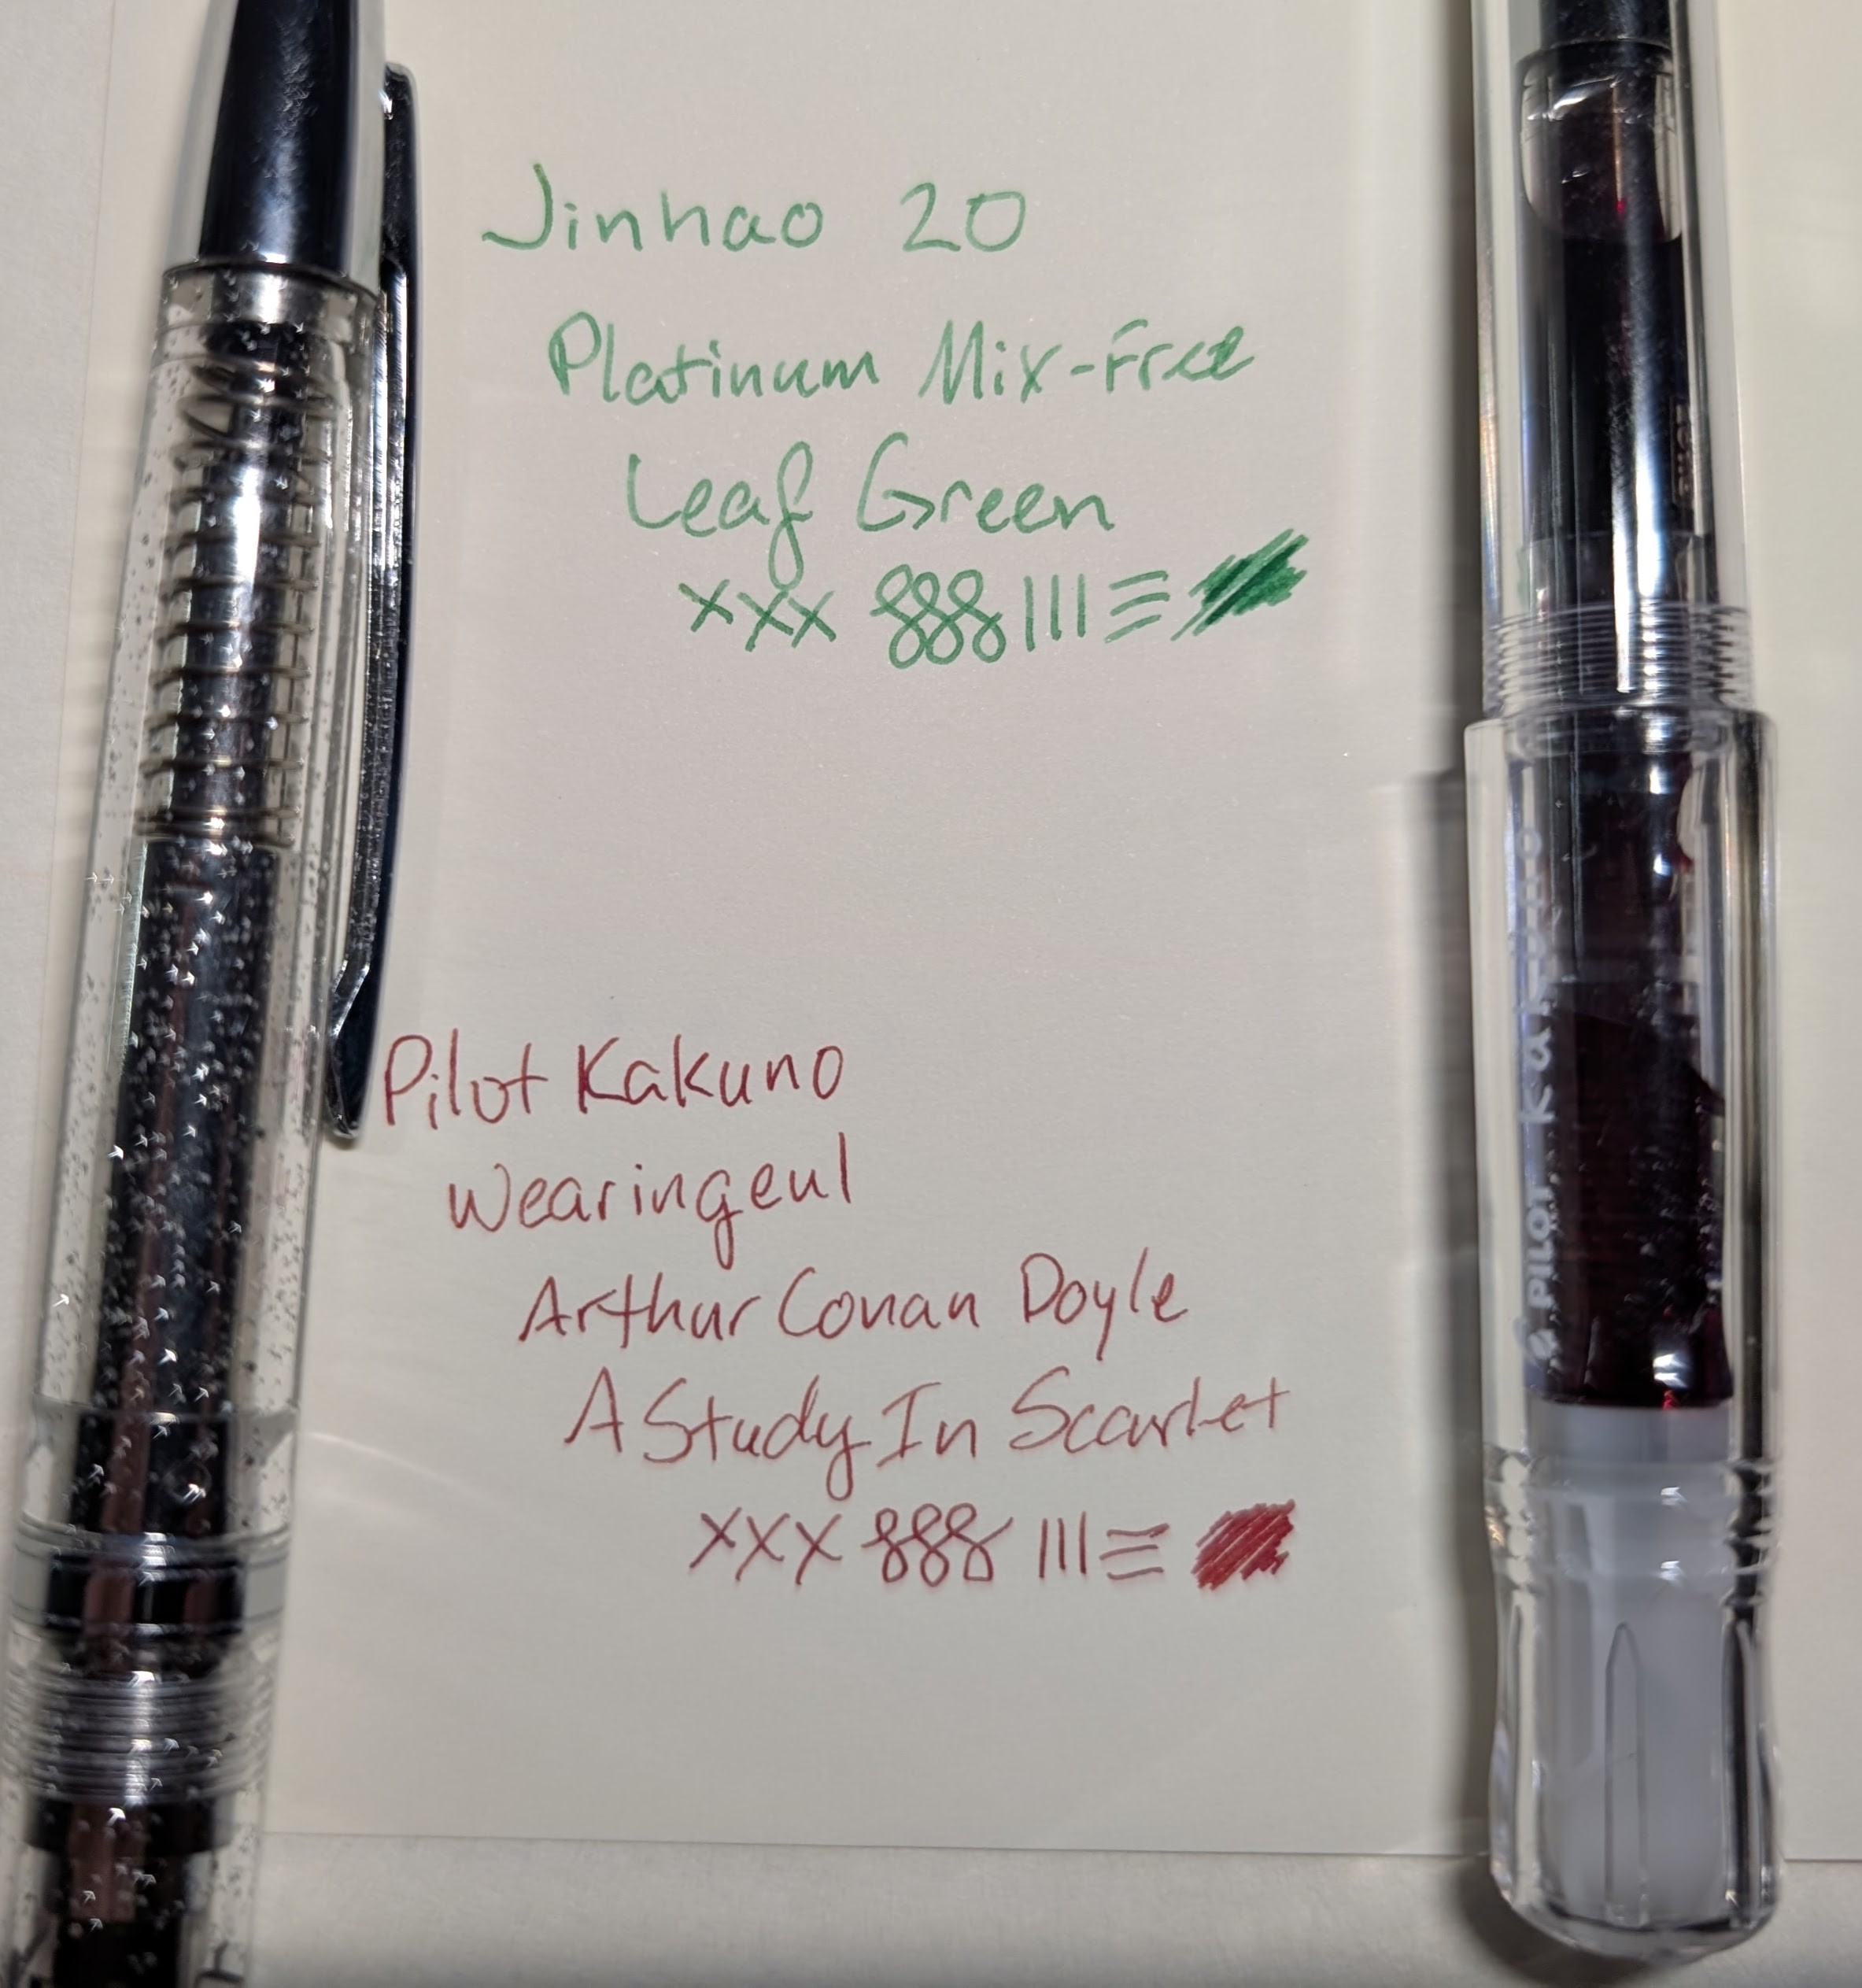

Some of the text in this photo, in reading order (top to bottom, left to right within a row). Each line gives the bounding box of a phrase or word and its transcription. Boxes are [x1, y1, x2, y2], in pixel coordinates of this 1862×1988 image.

[479, 161, 1029, 253] Jinhao 20
[545, 309, 881, 406] Platinum
[625, 430, 1116, 591] Leaf Green
[869, 562, 1007, 669] 888
[382, 1026, 845, 1131] Pilot Kakuno
[1524, 1182, 1556, 1311] PILOT
[516, 1250, 1188, 1362] Arthur Conan Doyle
[562, 1365, 1291, 1502] A Study In Scarlet
